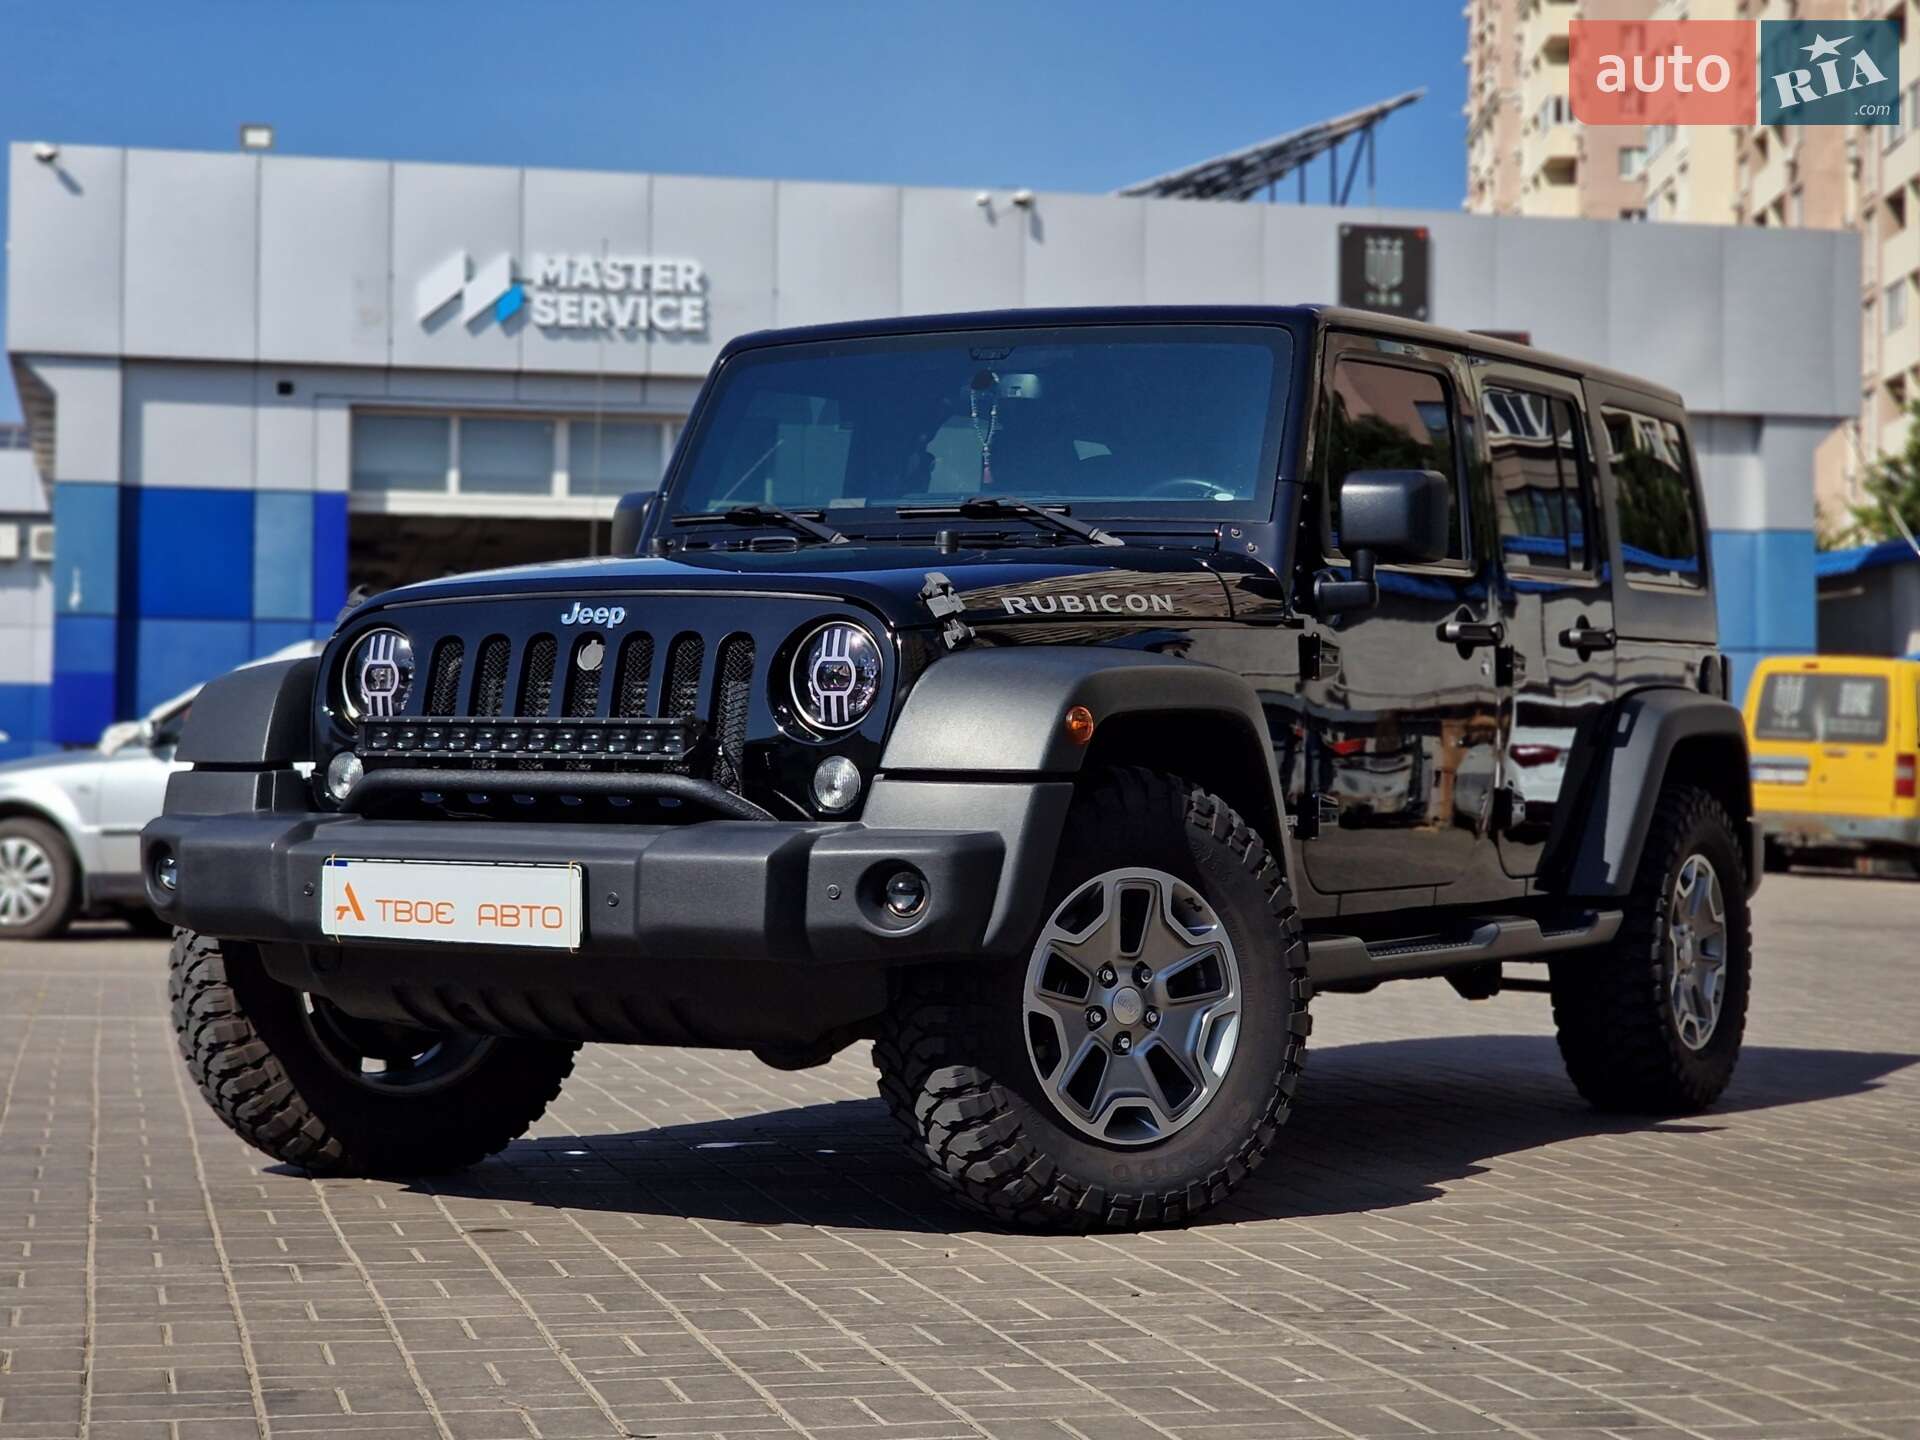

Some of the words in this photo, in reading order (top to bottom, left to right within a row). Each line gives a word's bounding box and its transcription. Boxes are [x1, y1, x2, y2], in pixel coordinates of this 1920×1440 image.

[533, 252, 703, 293] MASTER
[530, 293, 705, 331] SERVICE
[560, 601, 626, 629] Jeep
[1000, 594, 1175, 614] RUBICON
[375, 898, 456, 925] ТВОЄ
[477, 903, 563, 929] АВТО
